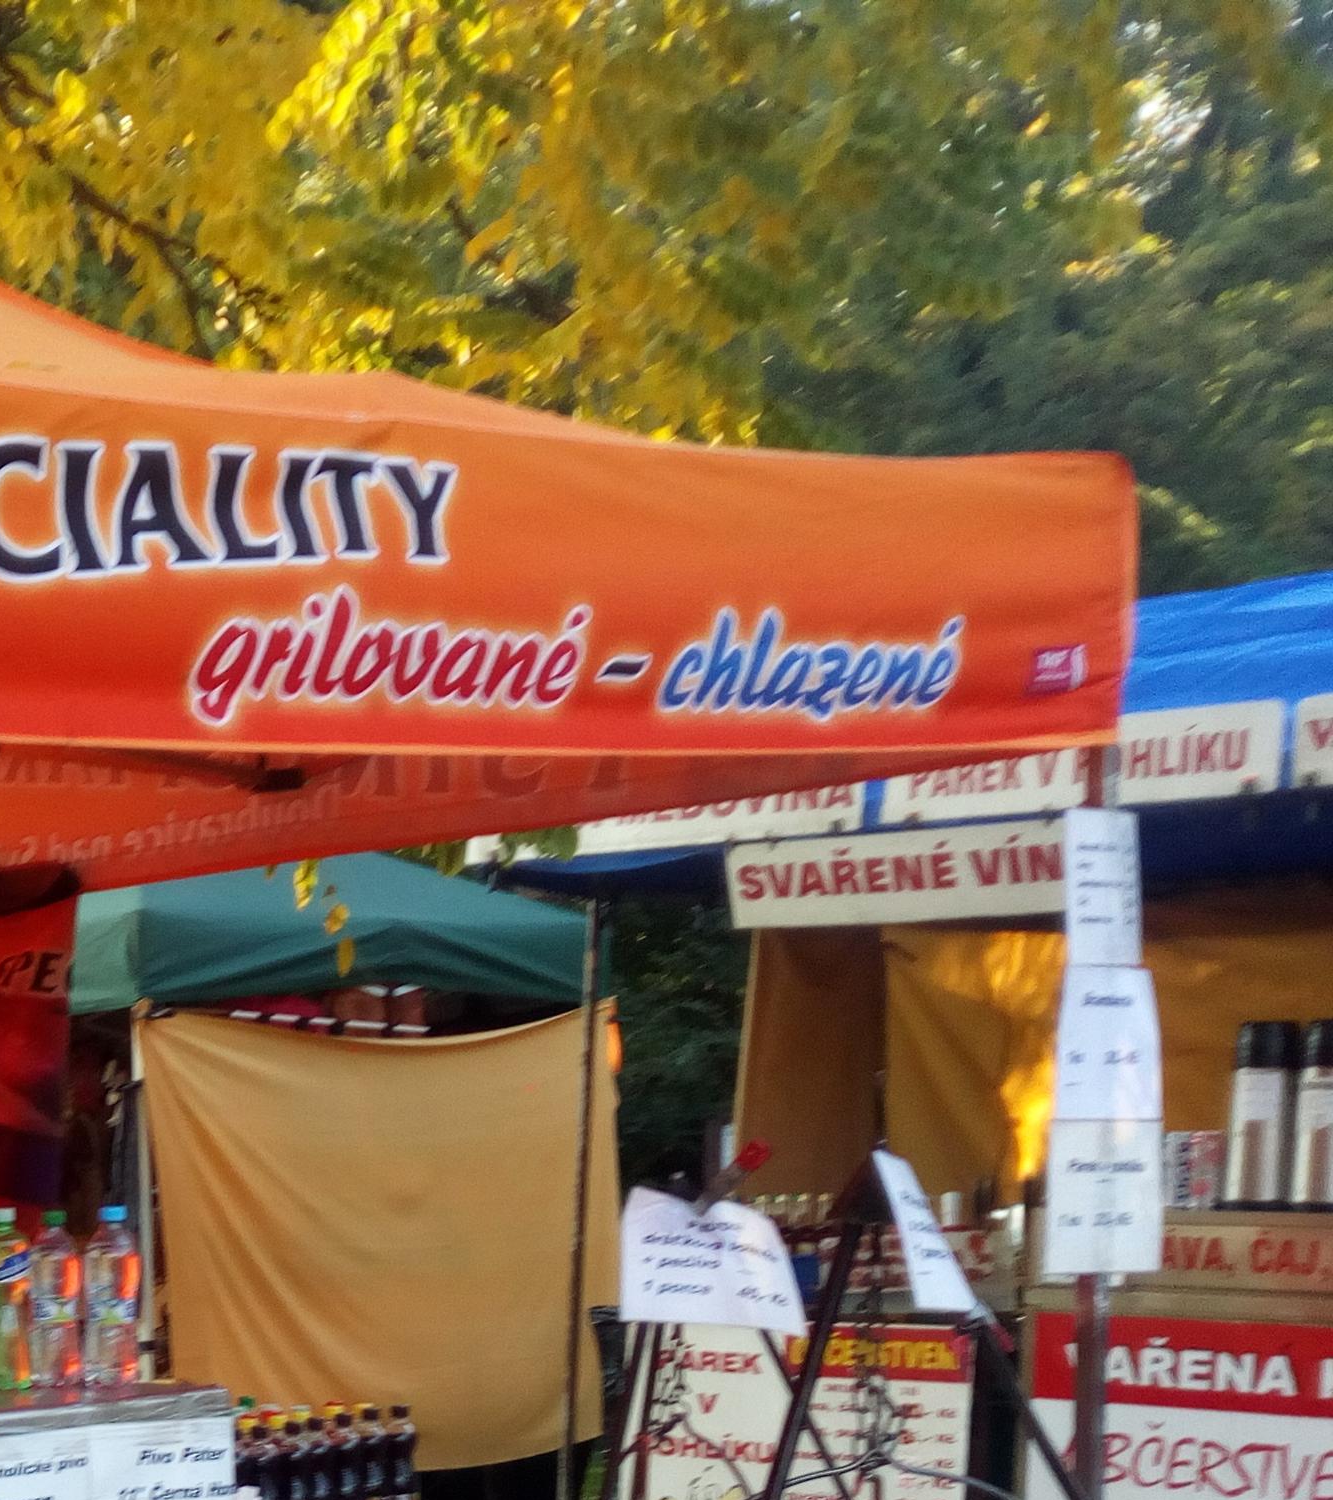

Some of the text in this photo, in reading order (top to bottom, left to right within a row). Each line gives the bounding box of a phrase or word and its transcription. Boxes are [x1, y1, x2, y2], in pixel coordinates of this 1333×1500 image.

[191, 586, 592, 727] grilované
[656, 608, 965, 725] chlazené
[1073, 723, 1250, 784] HLÍKU
[736, 840, 959, 901] SVAŘENÉ
[970, 834, 1065, 888] VÍN
[656, 1343, 763, 1374] PÁREK
[696, 1392, 720, 1414] V
[136, 1447, 174, 1466] Pivo
[206, 1481, 238, 1498] Hor
